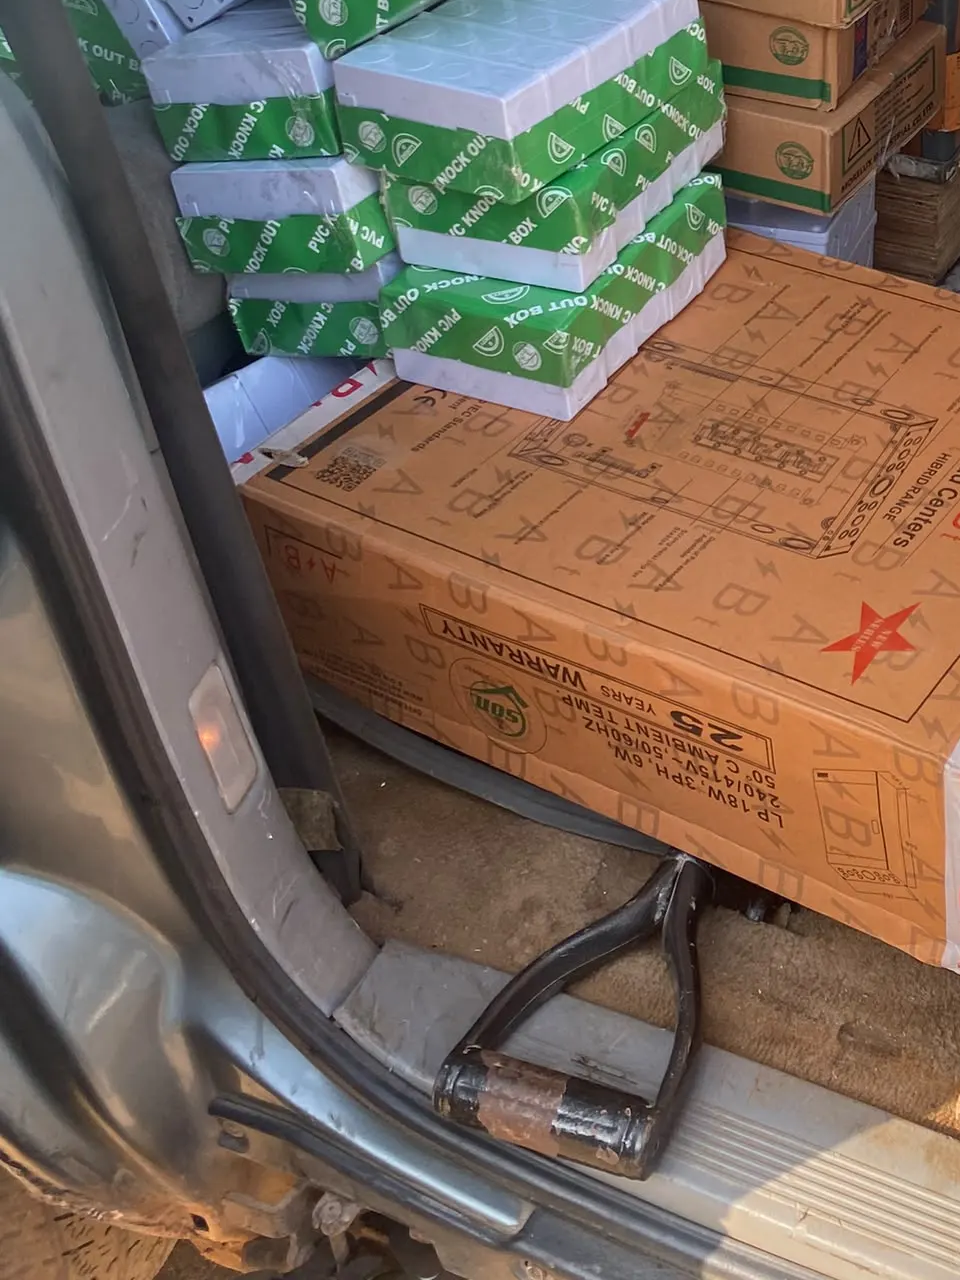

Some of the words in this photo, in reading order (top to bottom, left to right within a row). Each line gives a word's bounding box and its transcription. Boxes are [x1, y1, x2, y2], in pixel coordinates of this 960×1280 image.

[92, 45, 125, 65] OUT
[228, 113, 258, 158] KNOCK
[307, 225, 330, 253] PVC
[361, 226, 384, 248] PVC
[508, 218, 538, 245] BOX
[244, 242, 269, 273] NOCK
[423, 276, 486, 293] NOCK
[624, 266, 656, 291] KNOCK
[393, 288, 420, 312] OUT
[549, 296, 588, 311] OUT
[591, 295, 623, 320] KNOCK
[266, 301, 286, 327] BOX
[438, 308, 463, 332] PVC
[503, 305, 543, 328] BOX
[297, 312, 327, 354] KNOCK
[461, 404, 482, 418] IEC
[411, 417, 464, 452] Standards
[915, 453, 952, 490] HIBRID
[883, 486, 921, 521] RANGE
[893, 487, 958, 548] Centers
[443, 619, 588, 692] WARRANTY
[600, 684, 656, 714] YEARS
[625, 724, 720, 765] AMBIENT
[670, 709, 744, 753] 25
[759, 811, 783, 828] LP
